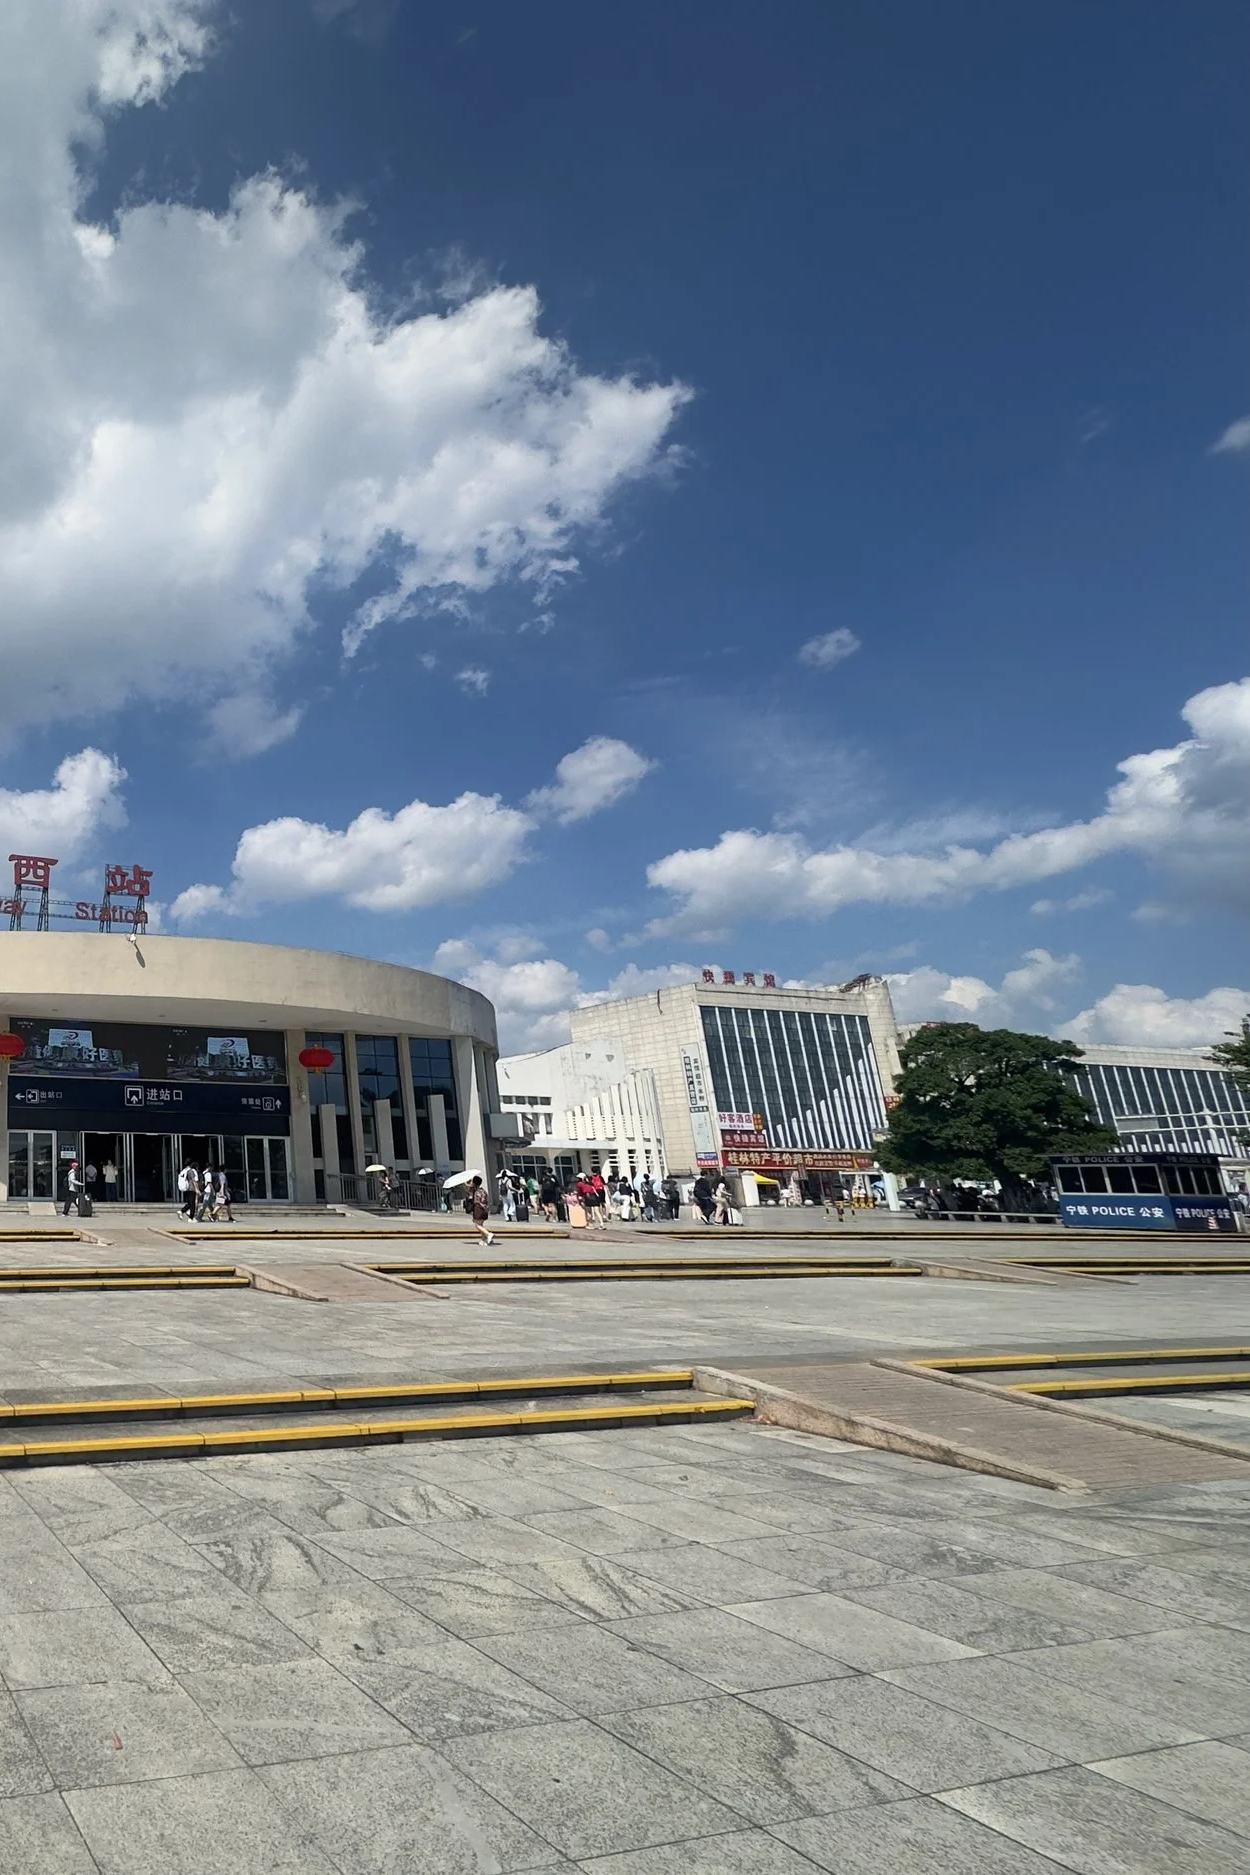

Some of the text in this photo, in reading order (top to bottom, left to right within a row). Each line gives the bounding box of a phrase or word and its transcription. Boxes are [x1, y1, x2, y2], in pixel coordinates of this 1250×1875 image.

[75, 902, 148, 924] Station
[40, 1090, 63, 1099] 出站口
[146, 1087, 183, 1101] 进站口
[719, 1113, 753, 1124] 好客酒店
[728, 1152, 814, 1166] 桂林特产平价超市
[1066, 1205, 1164, 1218] 宁铁 POLICE 公安
